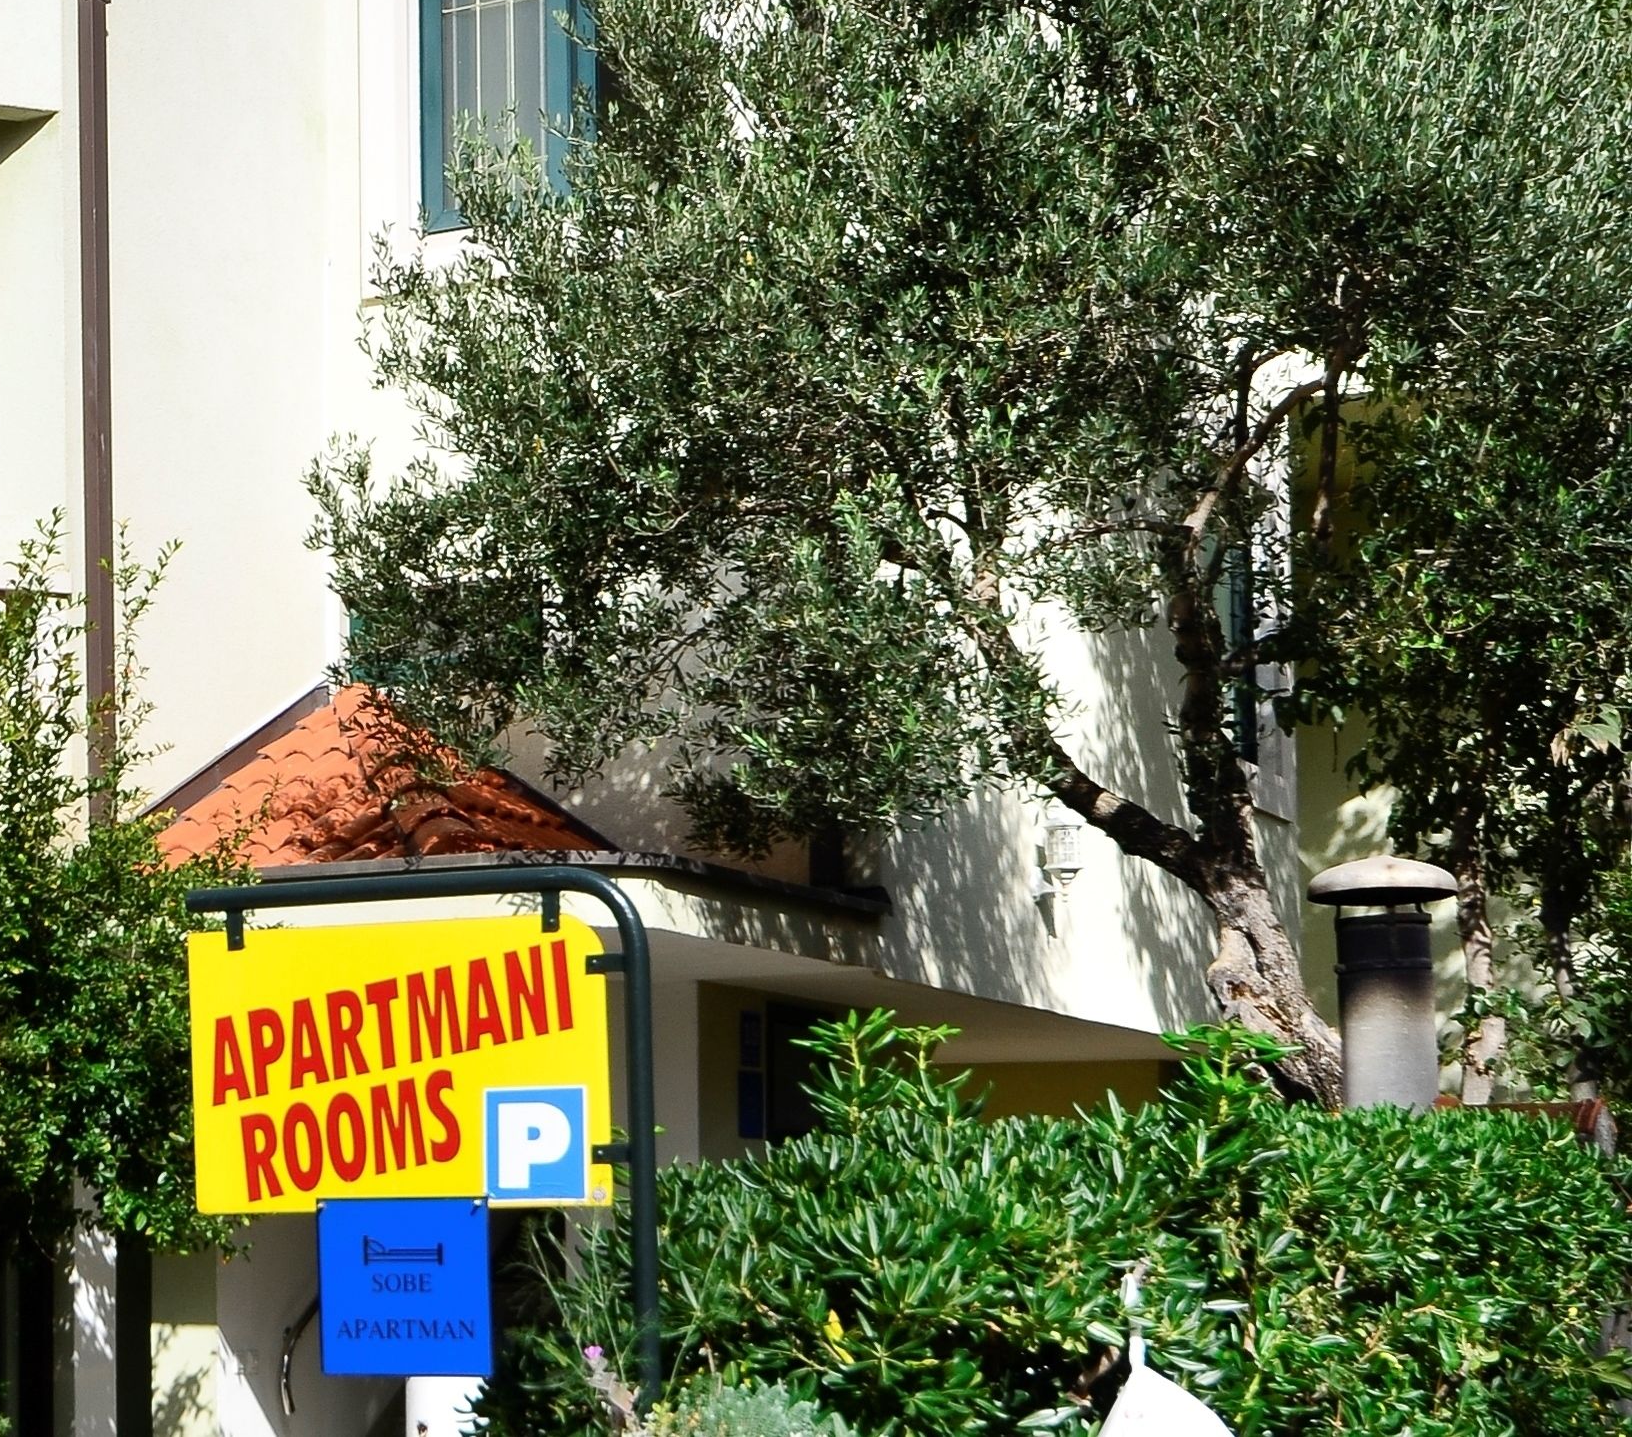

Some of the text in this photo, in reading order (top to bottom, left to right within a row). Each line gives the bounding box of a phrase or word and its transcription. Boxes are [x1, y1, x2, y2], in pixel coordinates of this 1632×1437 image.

[213, 940, 573, 1106] APARTMANI
[240, 1070, 461, 1202] ROOMS
[498, 1102, 571, 1189] P
[371, 1273, 433, 1293] SOBE
[337, 1319, 475, 1340] APARTMAN
